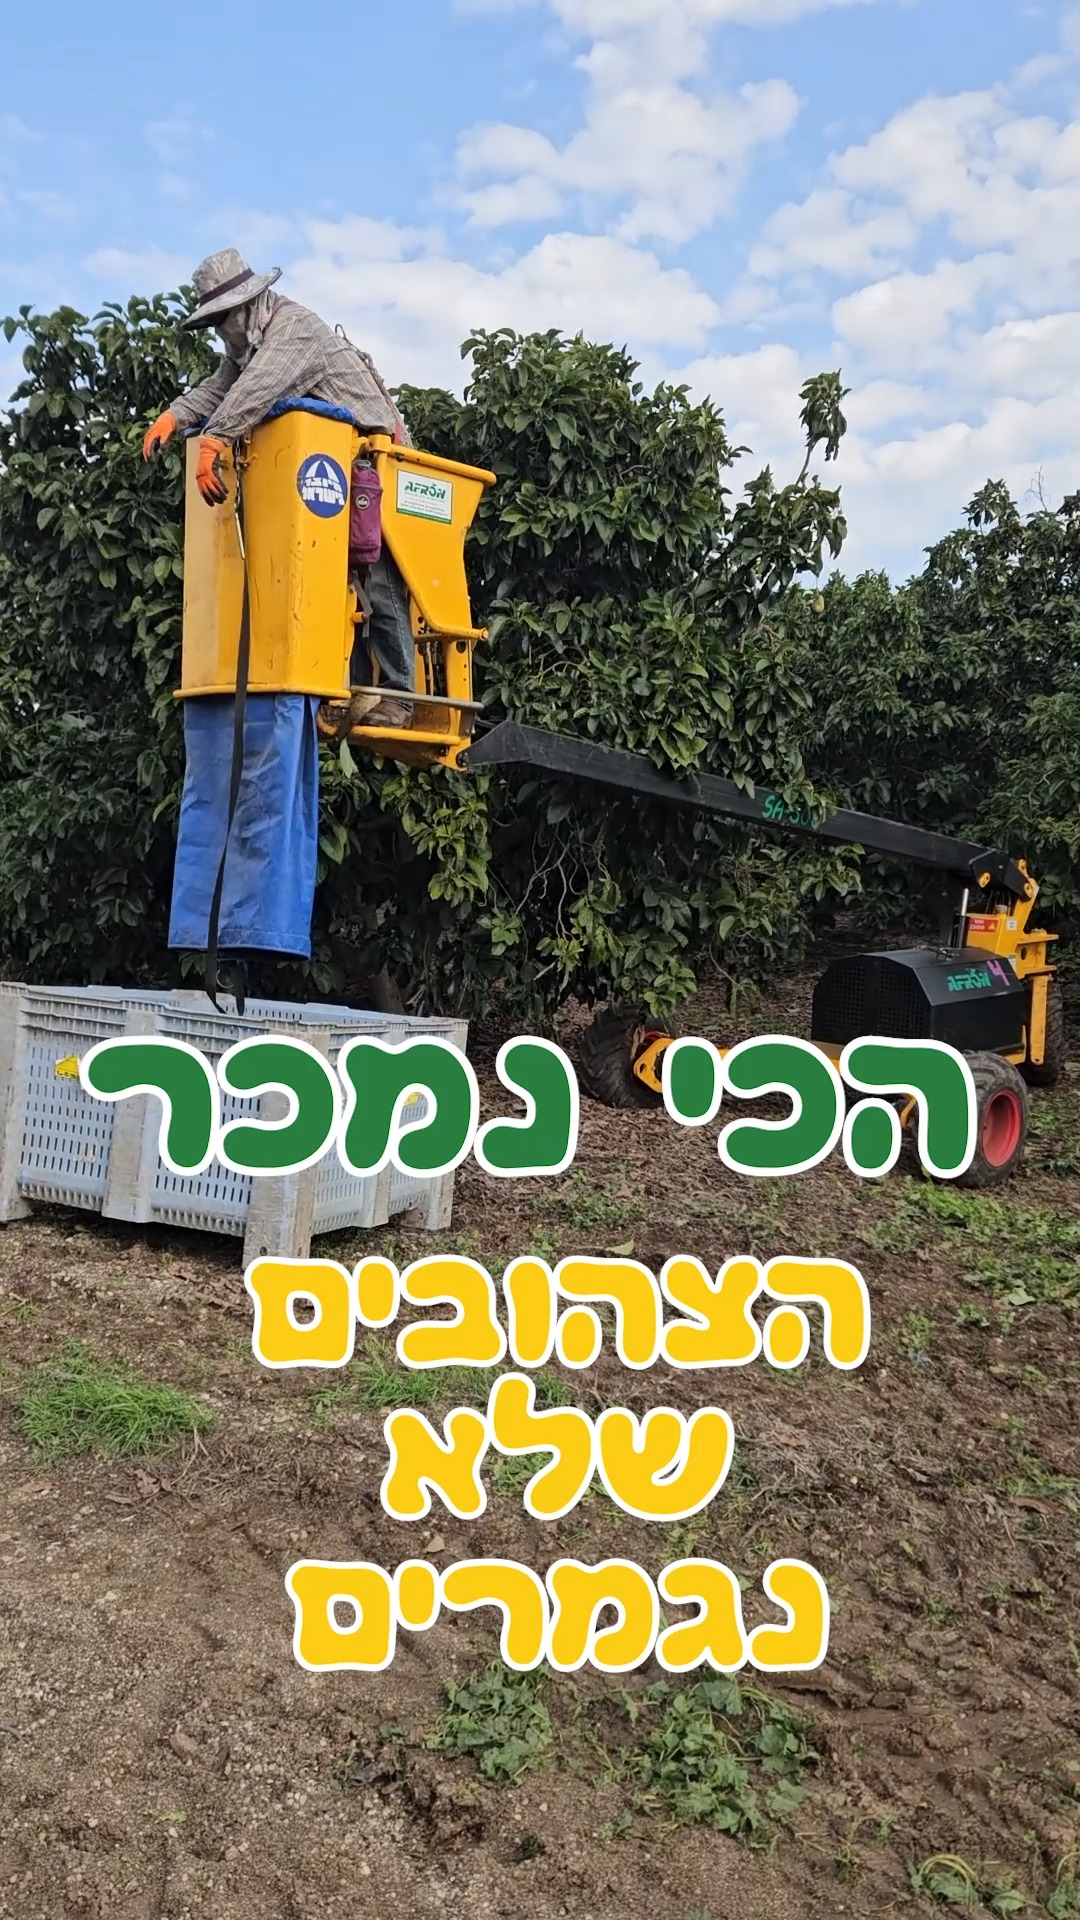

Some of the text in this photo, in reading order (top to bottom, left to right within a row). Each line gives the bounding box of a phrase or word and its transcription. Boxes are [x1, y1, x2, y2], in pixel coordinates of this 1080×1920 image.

[404, 481, 446, 499] AFRON
[947, 968, 992, 991] AFRON
[986, 960, 1010, 986] 4
